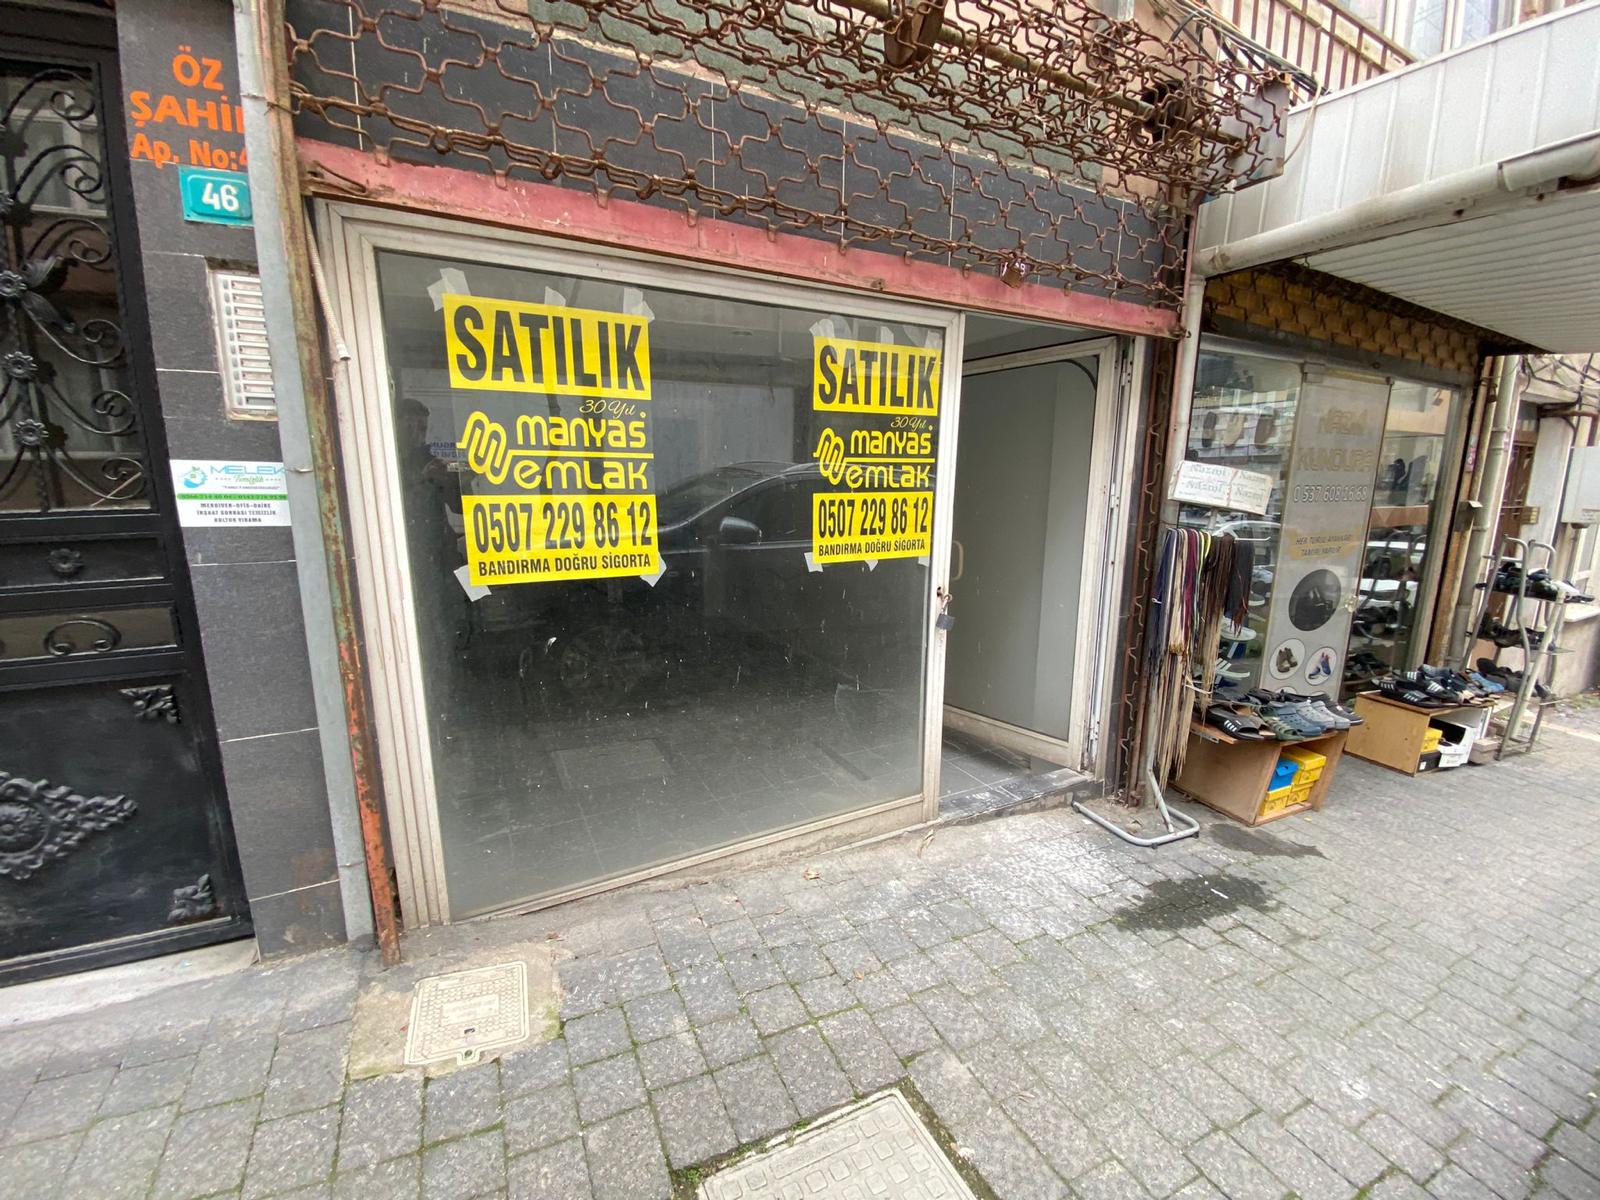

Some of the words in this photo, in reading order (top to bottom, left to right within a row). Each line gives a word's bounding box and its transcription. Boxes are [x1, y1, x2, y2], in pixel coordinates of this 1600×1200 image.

[173, 45, 224, 91] ÖZ
[130, 132, 180, 169] Ap.
[202, 182, 239, 212] 46
[453, 305, 646, 392] SATILIK
[818, 345, 937, 409] SATILIK
[579, 400, 607, 414] 30
[890, 416, 908, 428] 30
[516, 414, 647, 449] manyas
[850, 430, 931, 455] manyas
[472, 501, 534, 554] 0507
[543, 501, 586, 550] 229
[594, 500, 619, 549] 86
[627, 500, 653, 547] 12
[818, 498, 855, 539] 0507
[860, 497, 886, 537] 229
[891, 496, 908, 535] 86
[913, 496, 929, 534] 12
[478, 557, 551, 577] BANDIRMA
[555, 553, 598, 573] DOĞRU
[602, 551, 651, 570] SİGORTA
[818, 541, 863, 557] BANDIRMA
[865, 538, 892, 553] DOĞRU
[894, 537, 925, 551] SİGORTA
